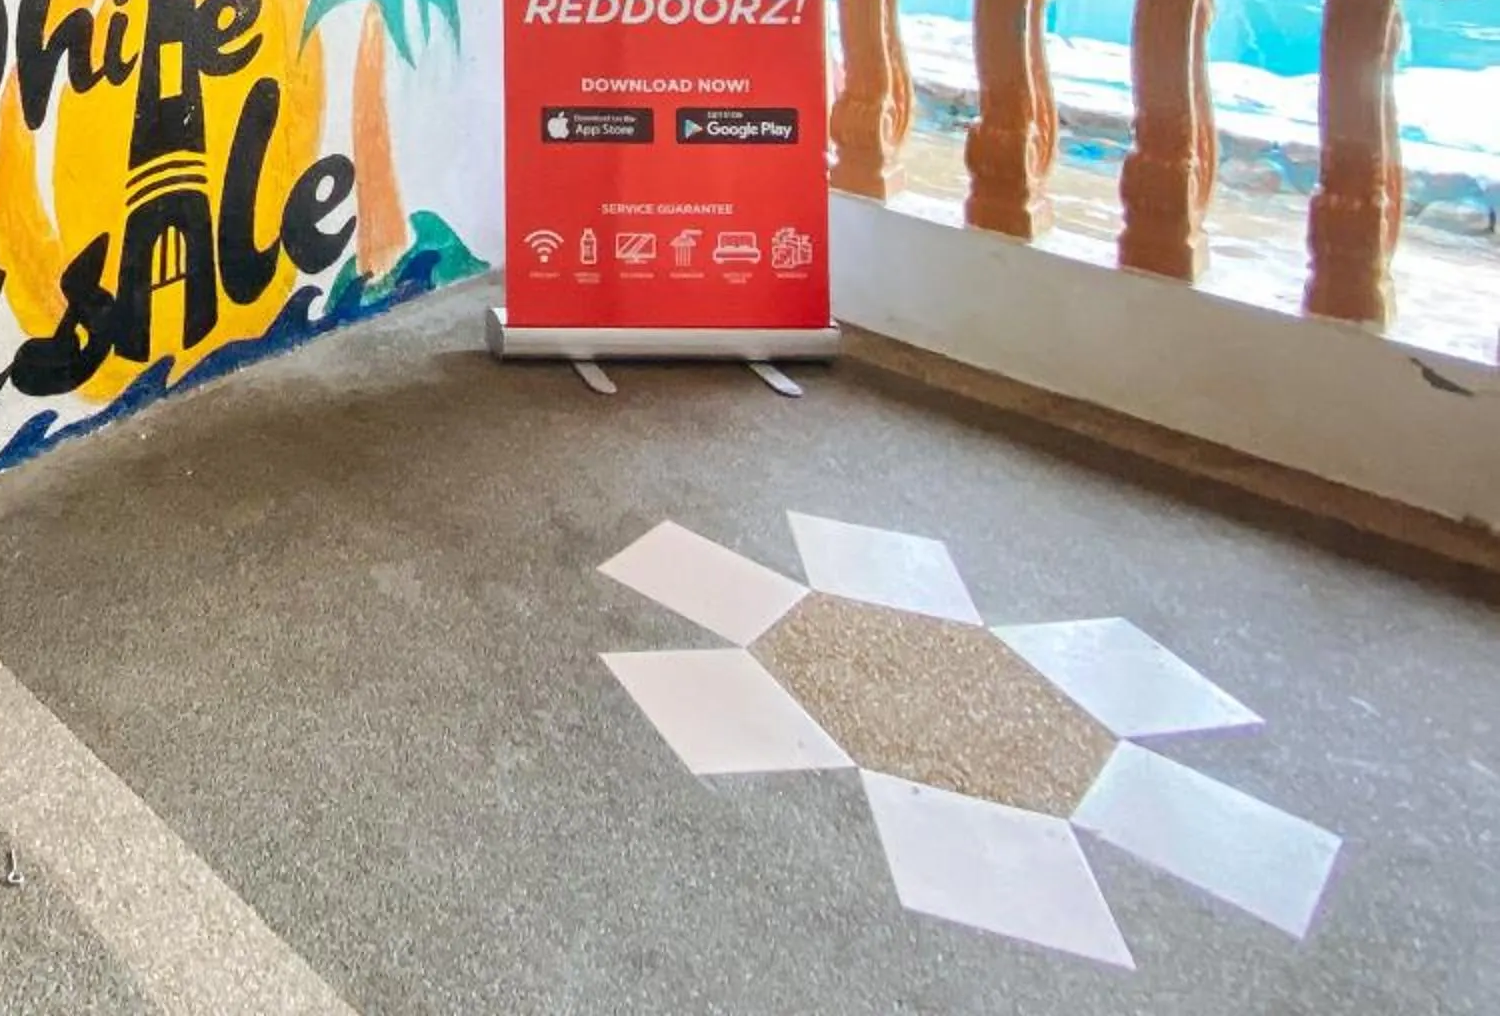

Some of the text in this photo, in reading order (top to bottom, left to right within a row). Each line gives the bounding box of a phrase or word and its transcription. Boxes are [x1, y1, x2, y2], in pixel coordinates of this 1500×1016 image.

[581, 78, 750, 93] DOWNLOAD NOW!
[575, 123, 635, 137] App Store
[707, 121, 793, 139] Google Play
[601, 203, 733, 215] SERVICE GUARANTEE
